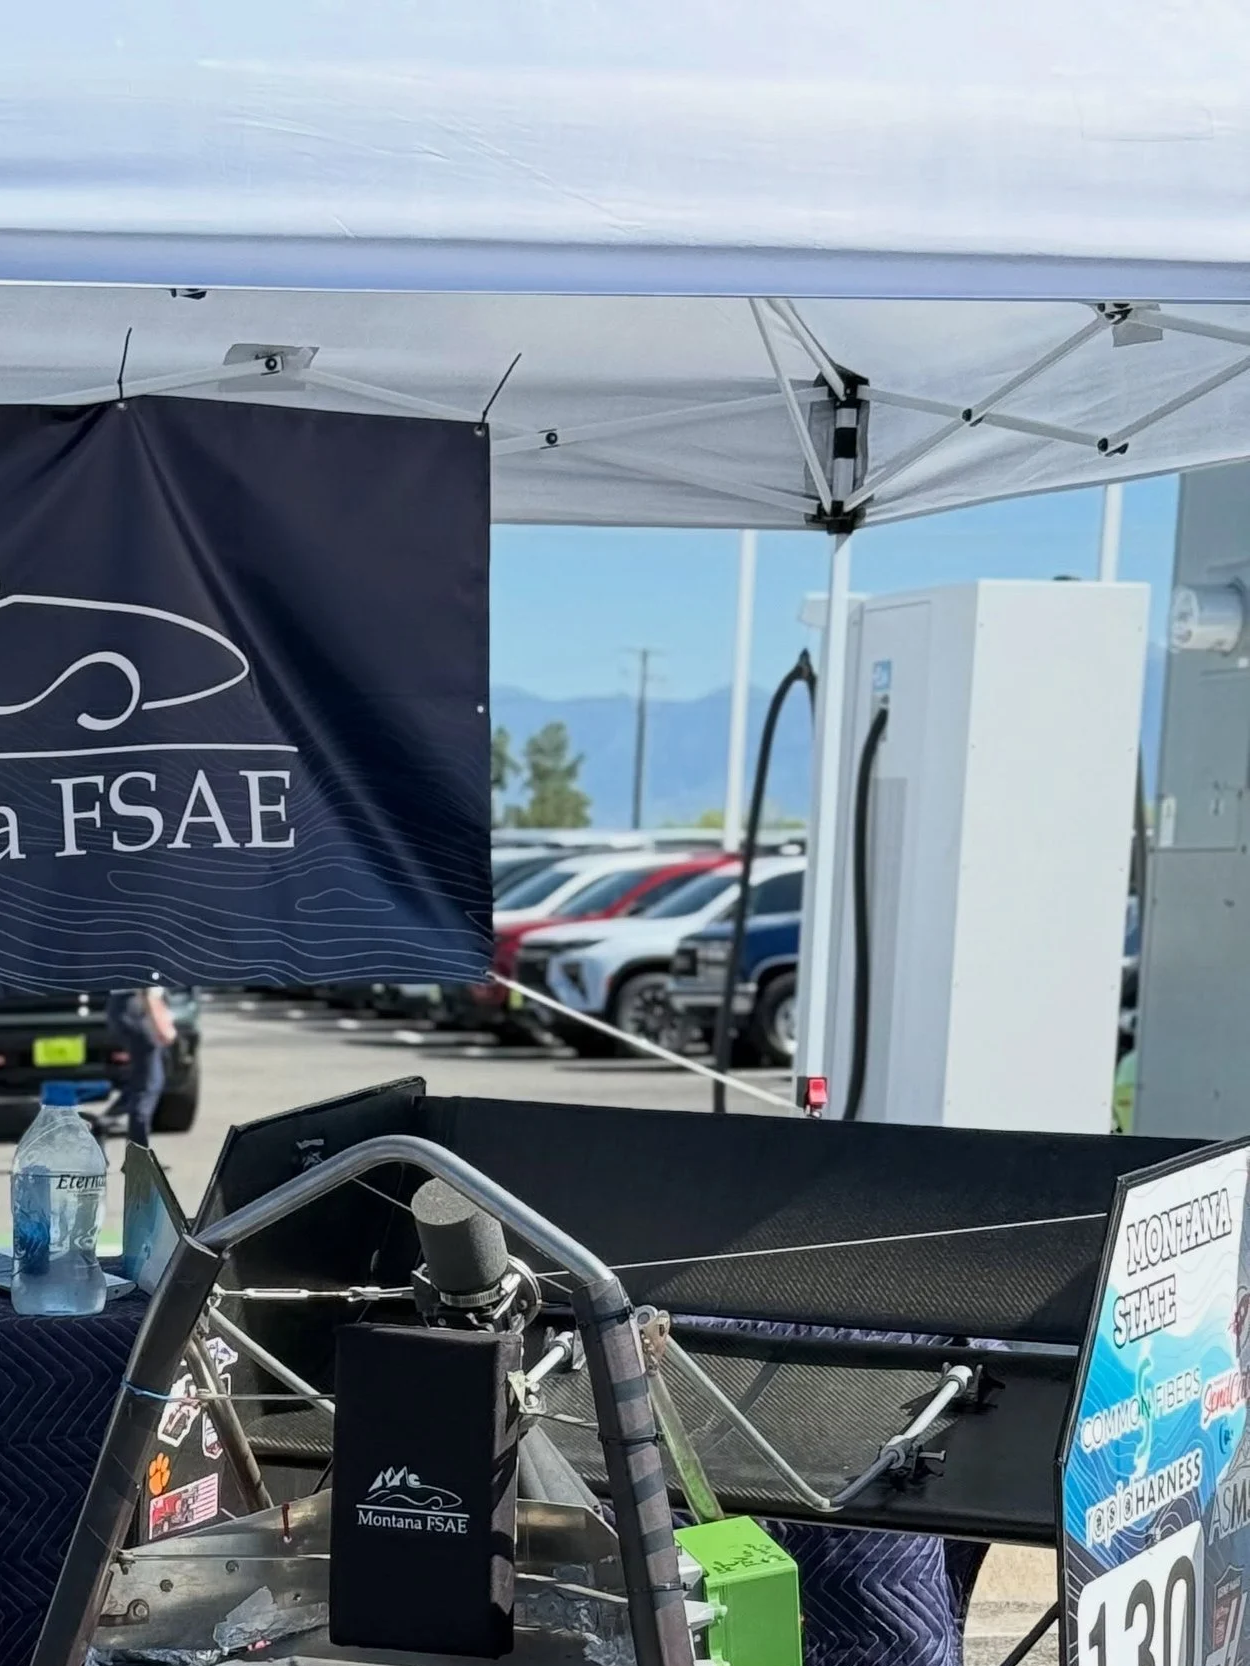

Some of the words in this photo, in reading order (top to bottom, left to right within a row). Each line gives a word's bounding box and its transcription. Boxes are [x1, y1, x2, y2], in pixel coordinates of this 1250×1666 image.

[54, 769, 298, 857] FSAE
[1127, 1188, 1232, 1276] MONTANA
[1113, 1274, 1176, 1349] STATE
[1083, 1396, 1151, 1449] COMMON
[1155, 1368, 1200, 1412] FIBERS
[358, 1510, 422, 1529] Montana
[426, 1516, 468, 1534] FSAE
